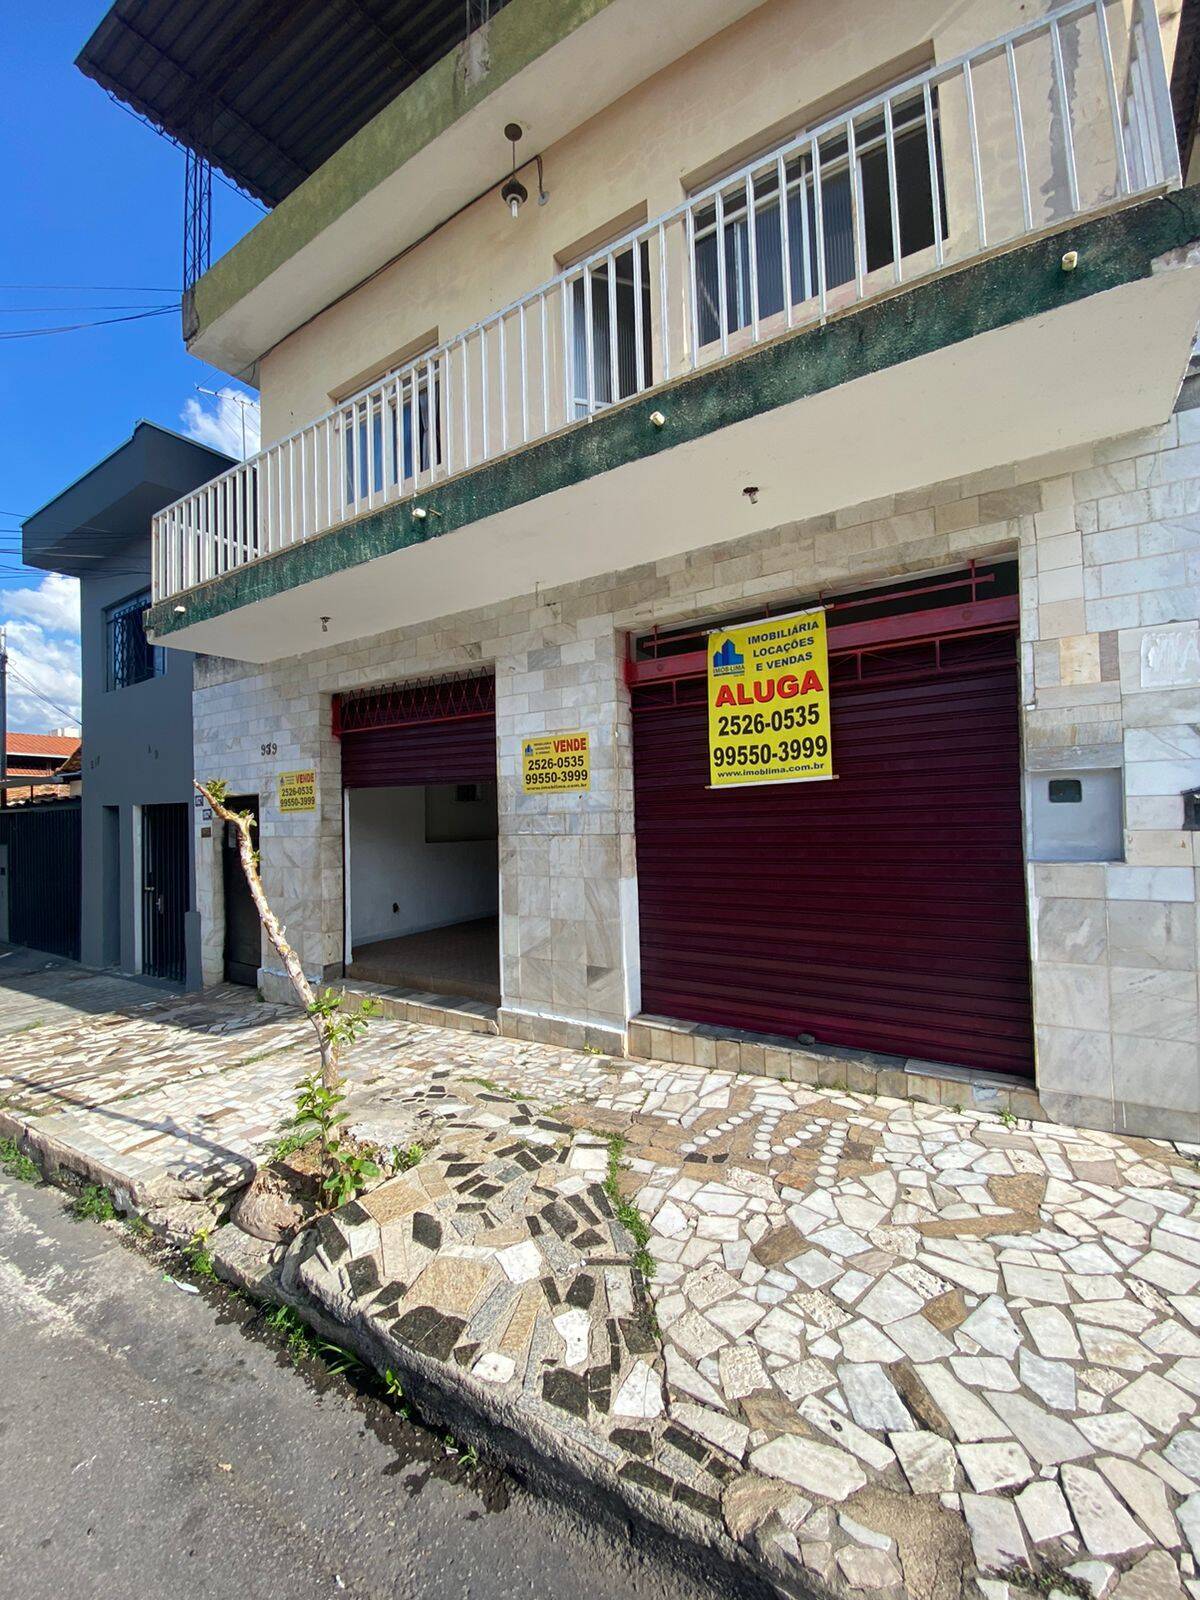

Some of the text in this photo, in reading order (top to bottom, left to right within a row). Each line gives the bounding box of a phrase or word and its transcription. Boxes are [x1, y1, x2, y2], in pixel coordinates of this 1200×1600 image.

[748, 620, 820, 645] IMOBILIÁRIA
[753, 636, 815, 658] LOCAÇÕES
[756, 652, 813, 672] E VENDAS
[715, 670, 823, 708] ALUGA
[718, 703, 820, 737] 2526-0535
[553, 737, 587, 753] VENDE
[713, 735, 828, 768] 99550-3999
[528, 755, 584, 771] 2526-0535
[717, 762, 825, 778] www.imoblima.com.br
[296, 773, 314, 784] VENDE
[525, 769, 588, 785] 99550-3999
